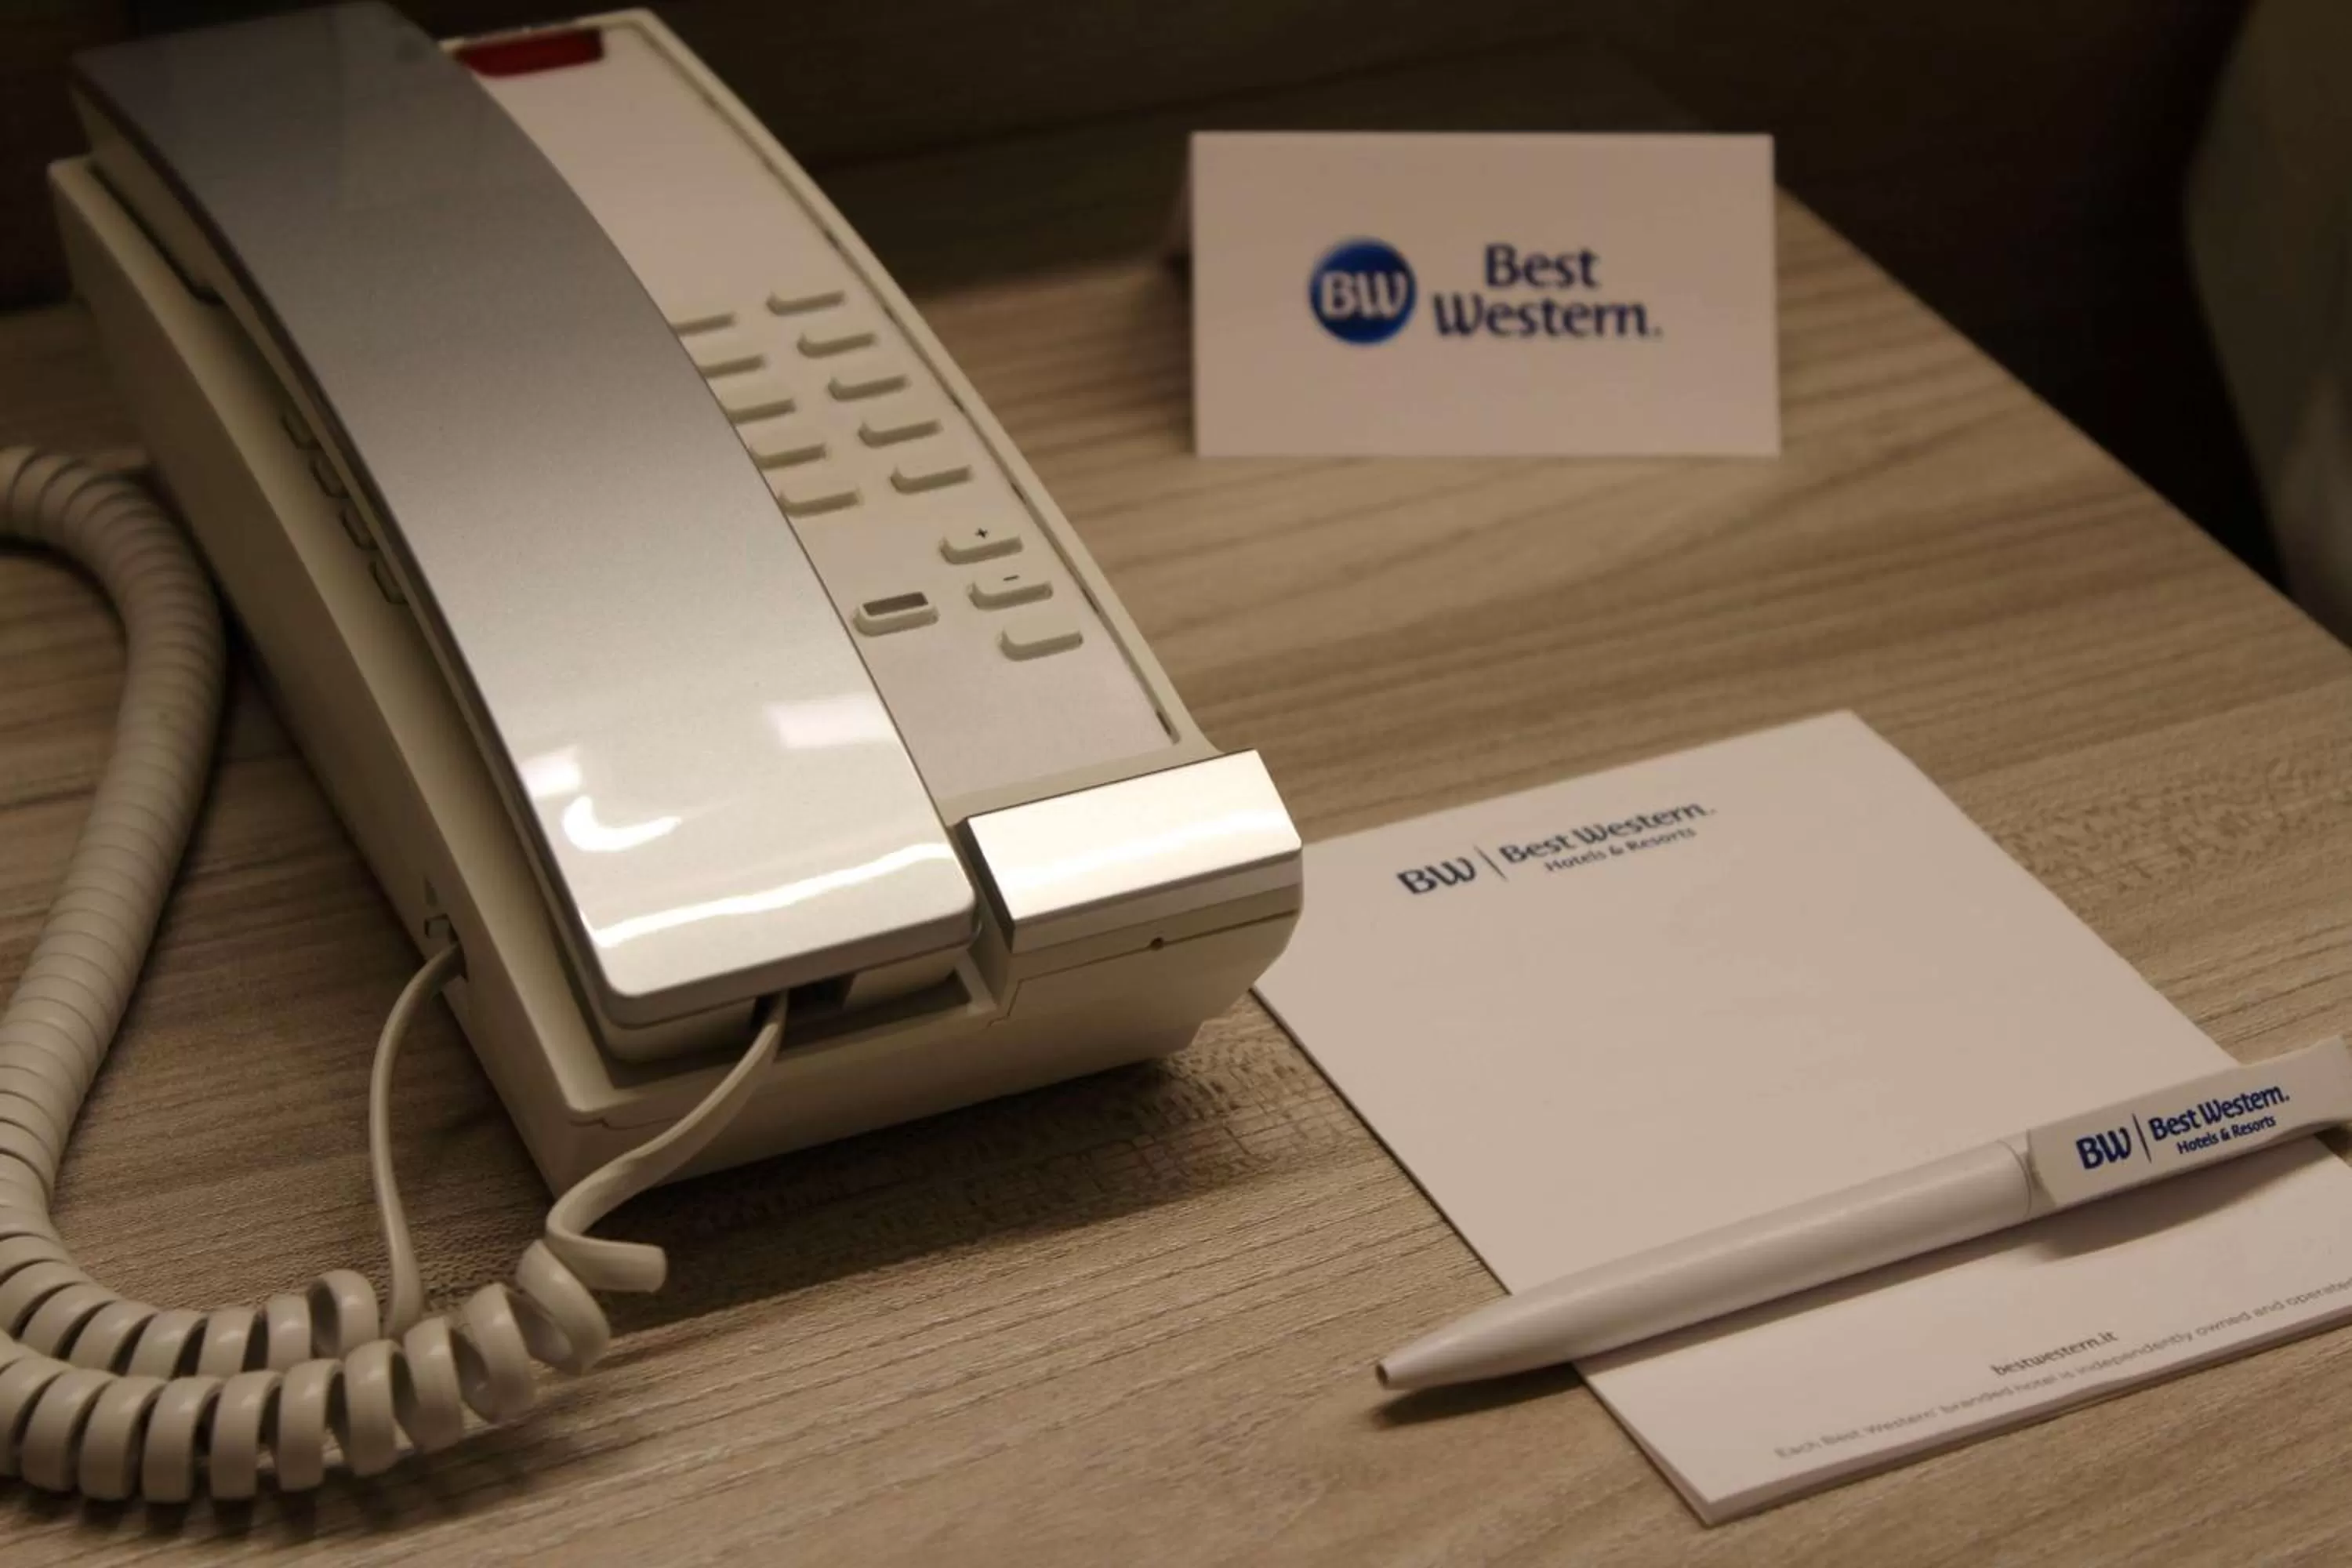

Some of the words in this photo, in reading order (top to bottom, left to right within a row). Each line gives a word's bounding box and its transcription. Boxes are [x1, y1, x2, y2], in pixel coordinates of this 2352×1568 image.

[1484, 244, 1599, 289] Best
[1320, 270, 1409, 321] BW
[1498, 834, 1573, 865] Best
[1544, 850, 1606, 873] Hotels
[1627, 826, 1697, 851] Resorts
[1396, 857, 1477, 895] BW
[2148, 1108, 2199, 1141] Best
[2176, 1132, 2219, 1154] Hotels
[2220, 1127, 2232, 1140] &
[2231, 1115, 2278, 1137] Resorts
[2076, 1127, 2133, 1169] BW
[1990, 1331, 2119, 1376] bestwestern.it
